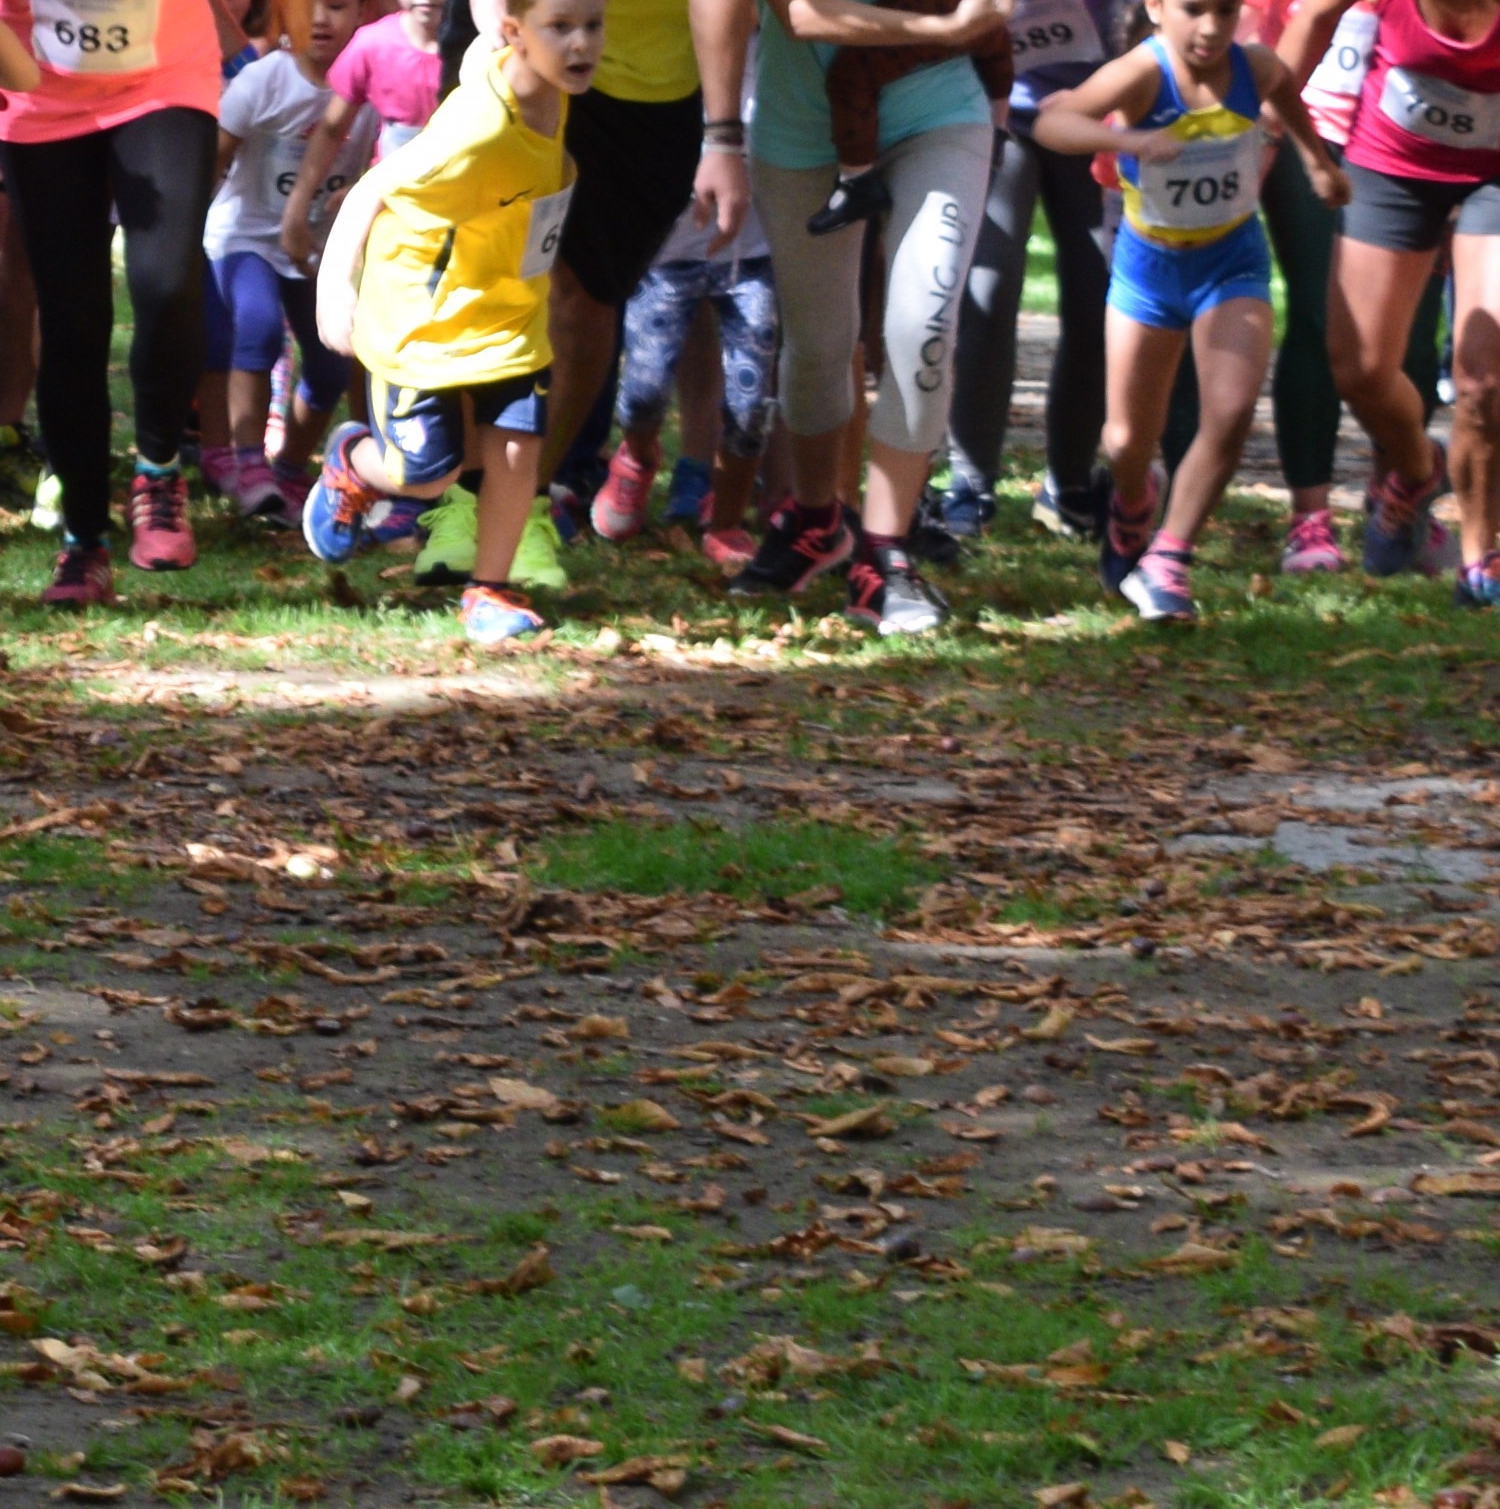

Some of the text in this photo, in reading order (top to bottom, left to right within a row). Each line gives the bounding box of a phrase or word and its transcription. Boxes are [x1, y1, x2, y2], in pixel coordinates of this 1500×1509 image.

[54, 19, 129, 53] 683
[1406, 98, 1474, 134] 708
[1166, 171, 1239, 207] 708
